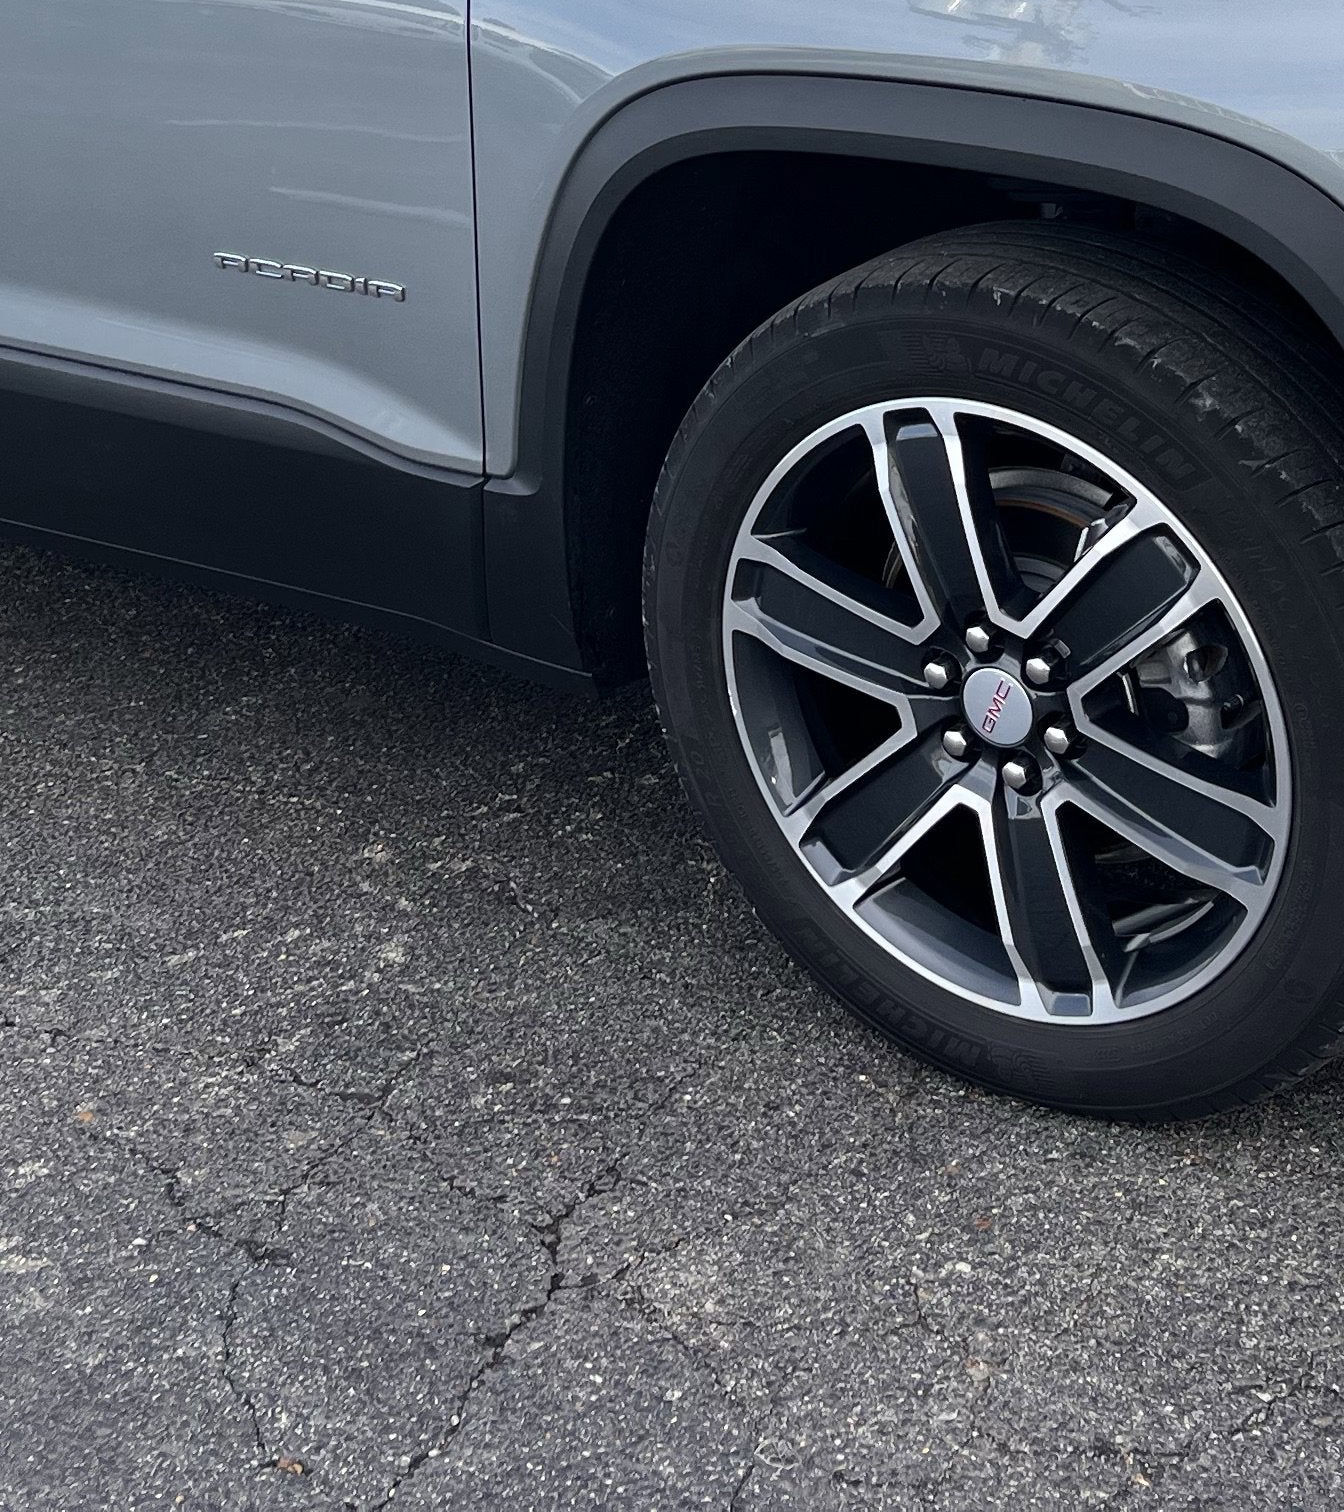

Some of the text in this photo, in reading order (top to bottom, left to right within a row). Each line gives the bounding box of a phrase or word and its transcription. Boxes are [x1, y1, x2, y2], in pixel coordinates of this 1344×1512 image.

[213, 251, 405, 302] ACADIA
[975, 345, 1197, 485] MICHELIN
[982, 677, 1014, 735] GMC
